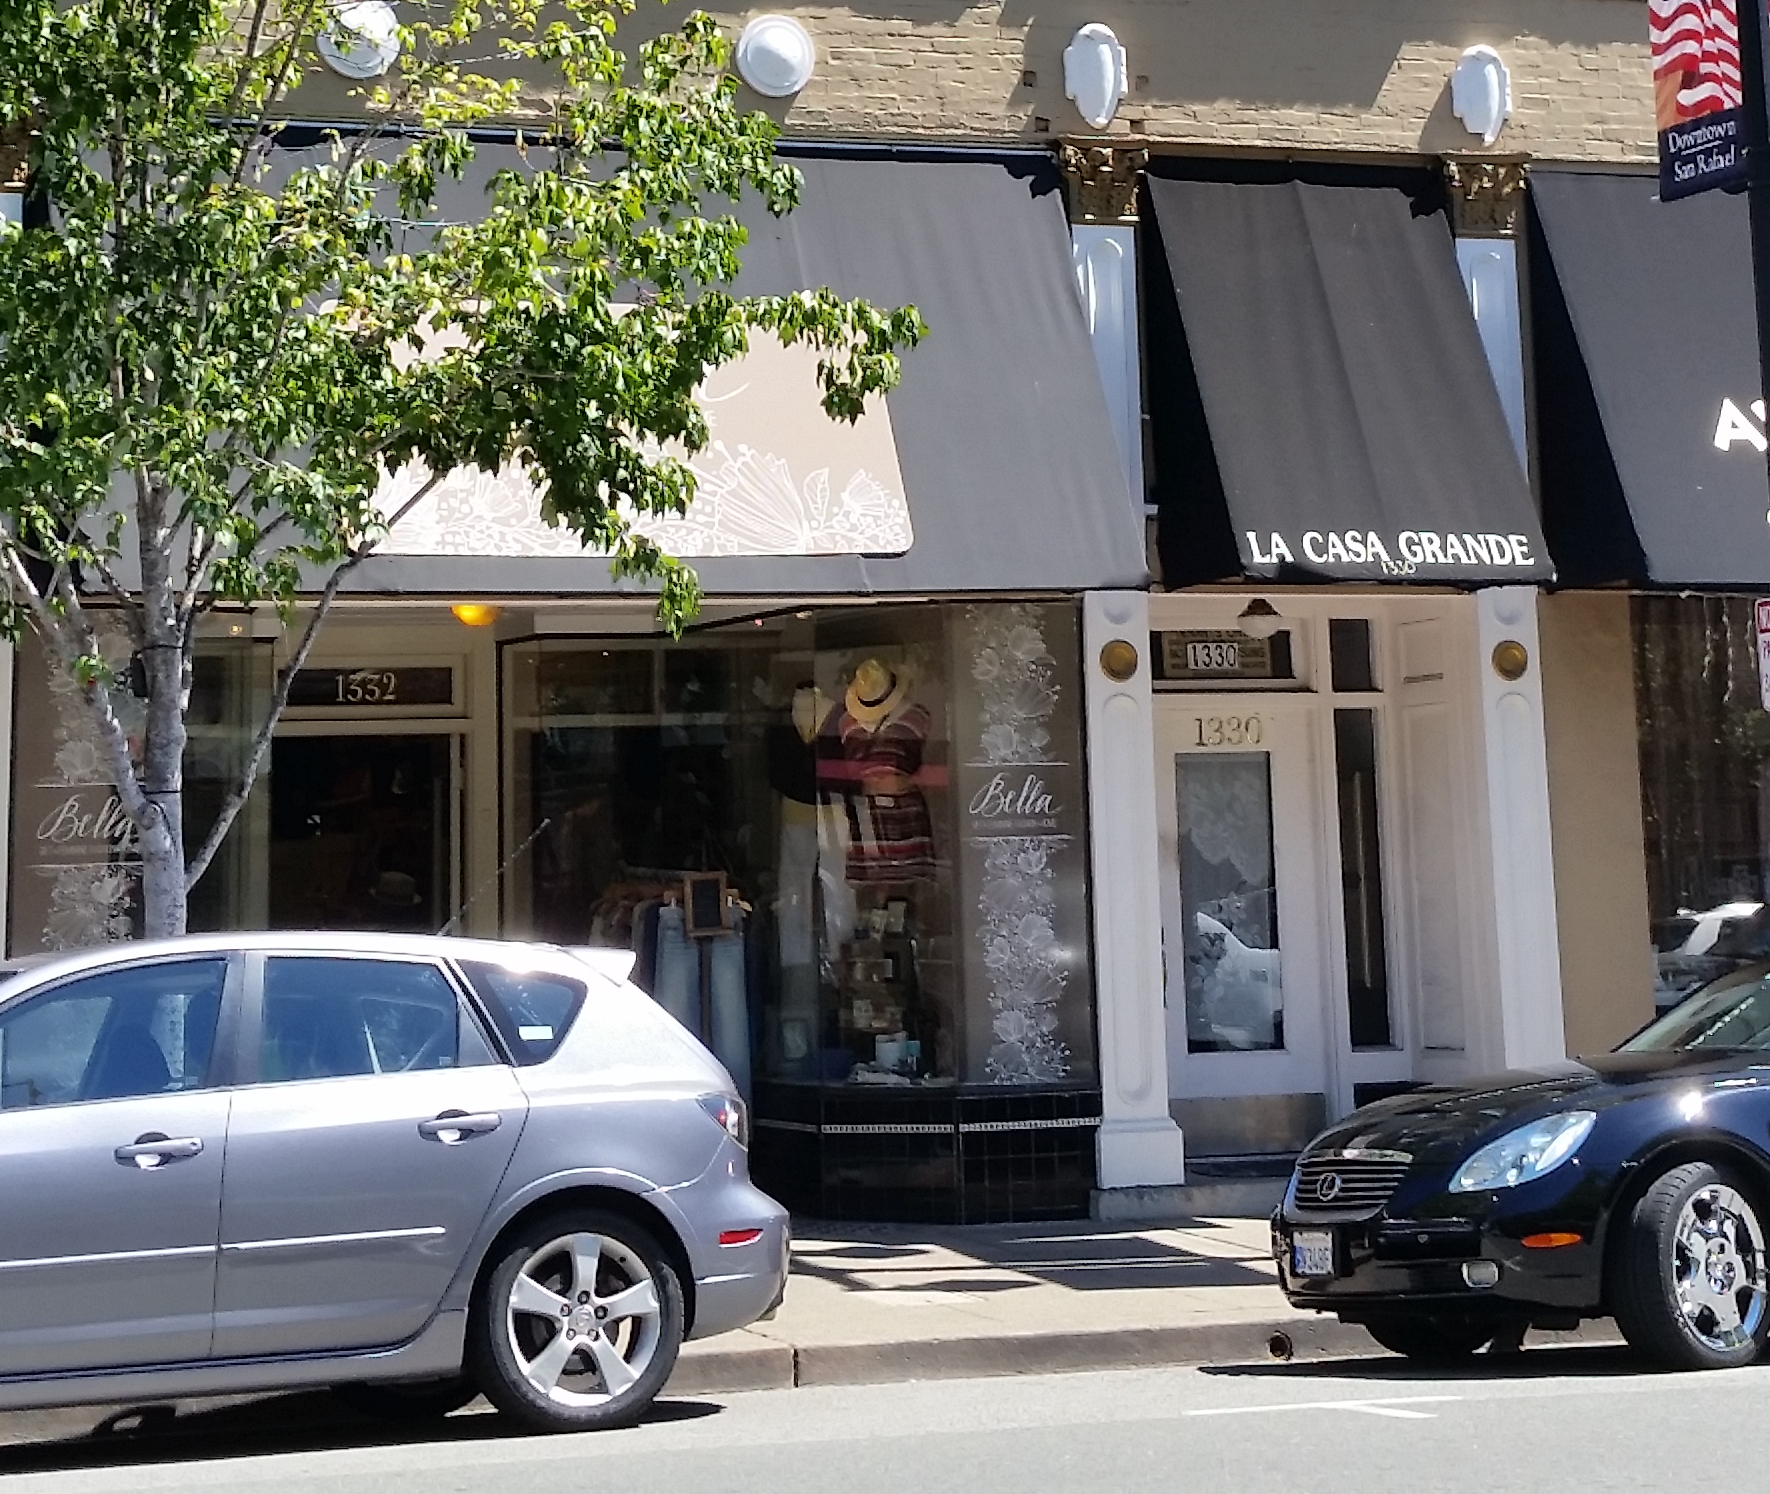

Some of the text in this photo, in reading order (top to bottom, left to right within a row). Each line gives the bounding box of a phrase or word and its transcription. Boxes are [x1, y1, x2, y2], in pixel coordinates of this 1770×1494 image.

[1667, 120, 1737, 154] Downtown
[1674, 144, 1736, 183] San Rafael
[1245, 530, 1535, 566] LA CASA GRANDE
[1191, 644, 1237, 668] 1330
[335, 672, 396, 702] 1332
[1195, 716, 1262, 747] 1330
[969, 772, 1063, 817] Bella
